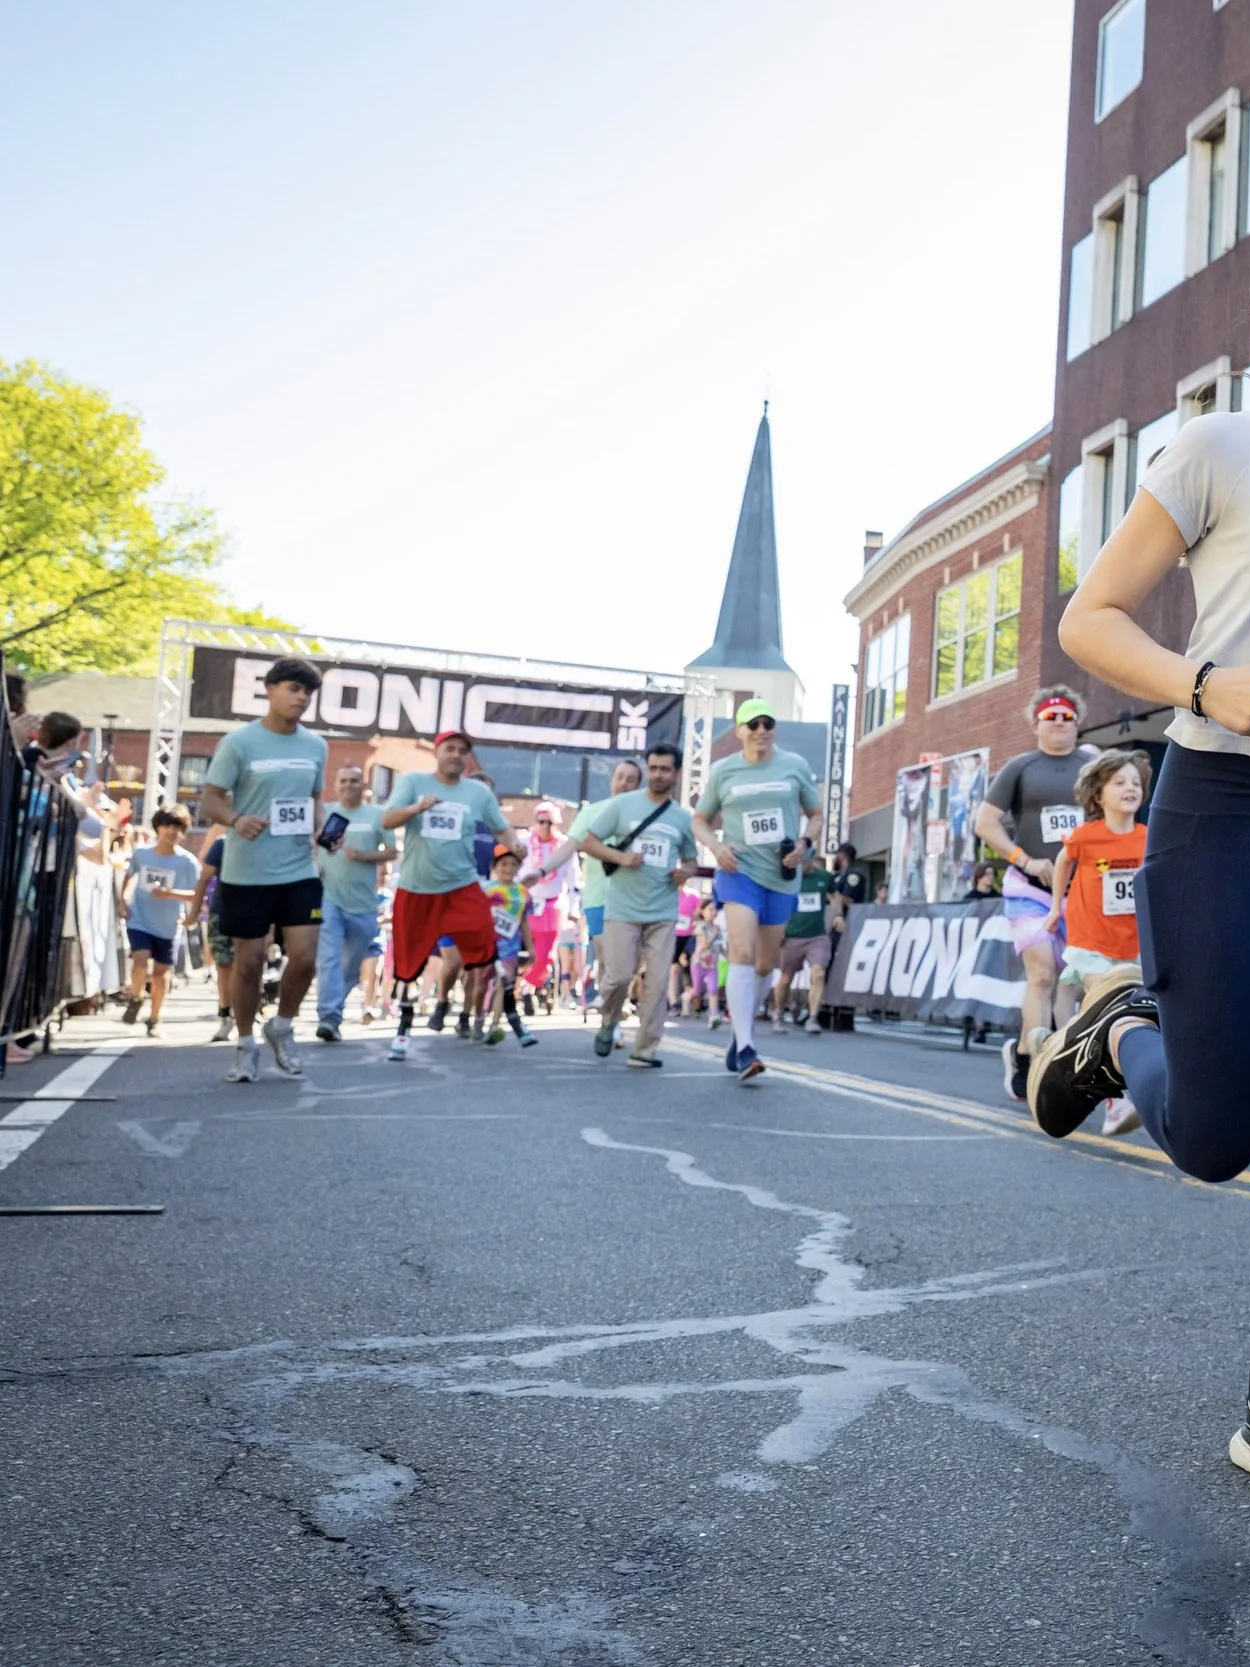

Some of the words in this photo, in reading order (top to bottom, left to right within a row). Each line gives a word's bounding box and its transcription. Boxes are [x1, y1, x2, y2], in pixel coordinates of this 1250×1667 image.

[616, 697, 650, 750] 5K
[832, 686, 847, 780] PAINTED
[279, 807, 305, 823] 954
[751, 817, 778, 833] 966
[827, 784, 841, 852] BURRO
[1050, 815, 1077, 830] 938
[1115, 880, 1135, 900] 93
[843, 915, 1027, 1008] BIONIC
